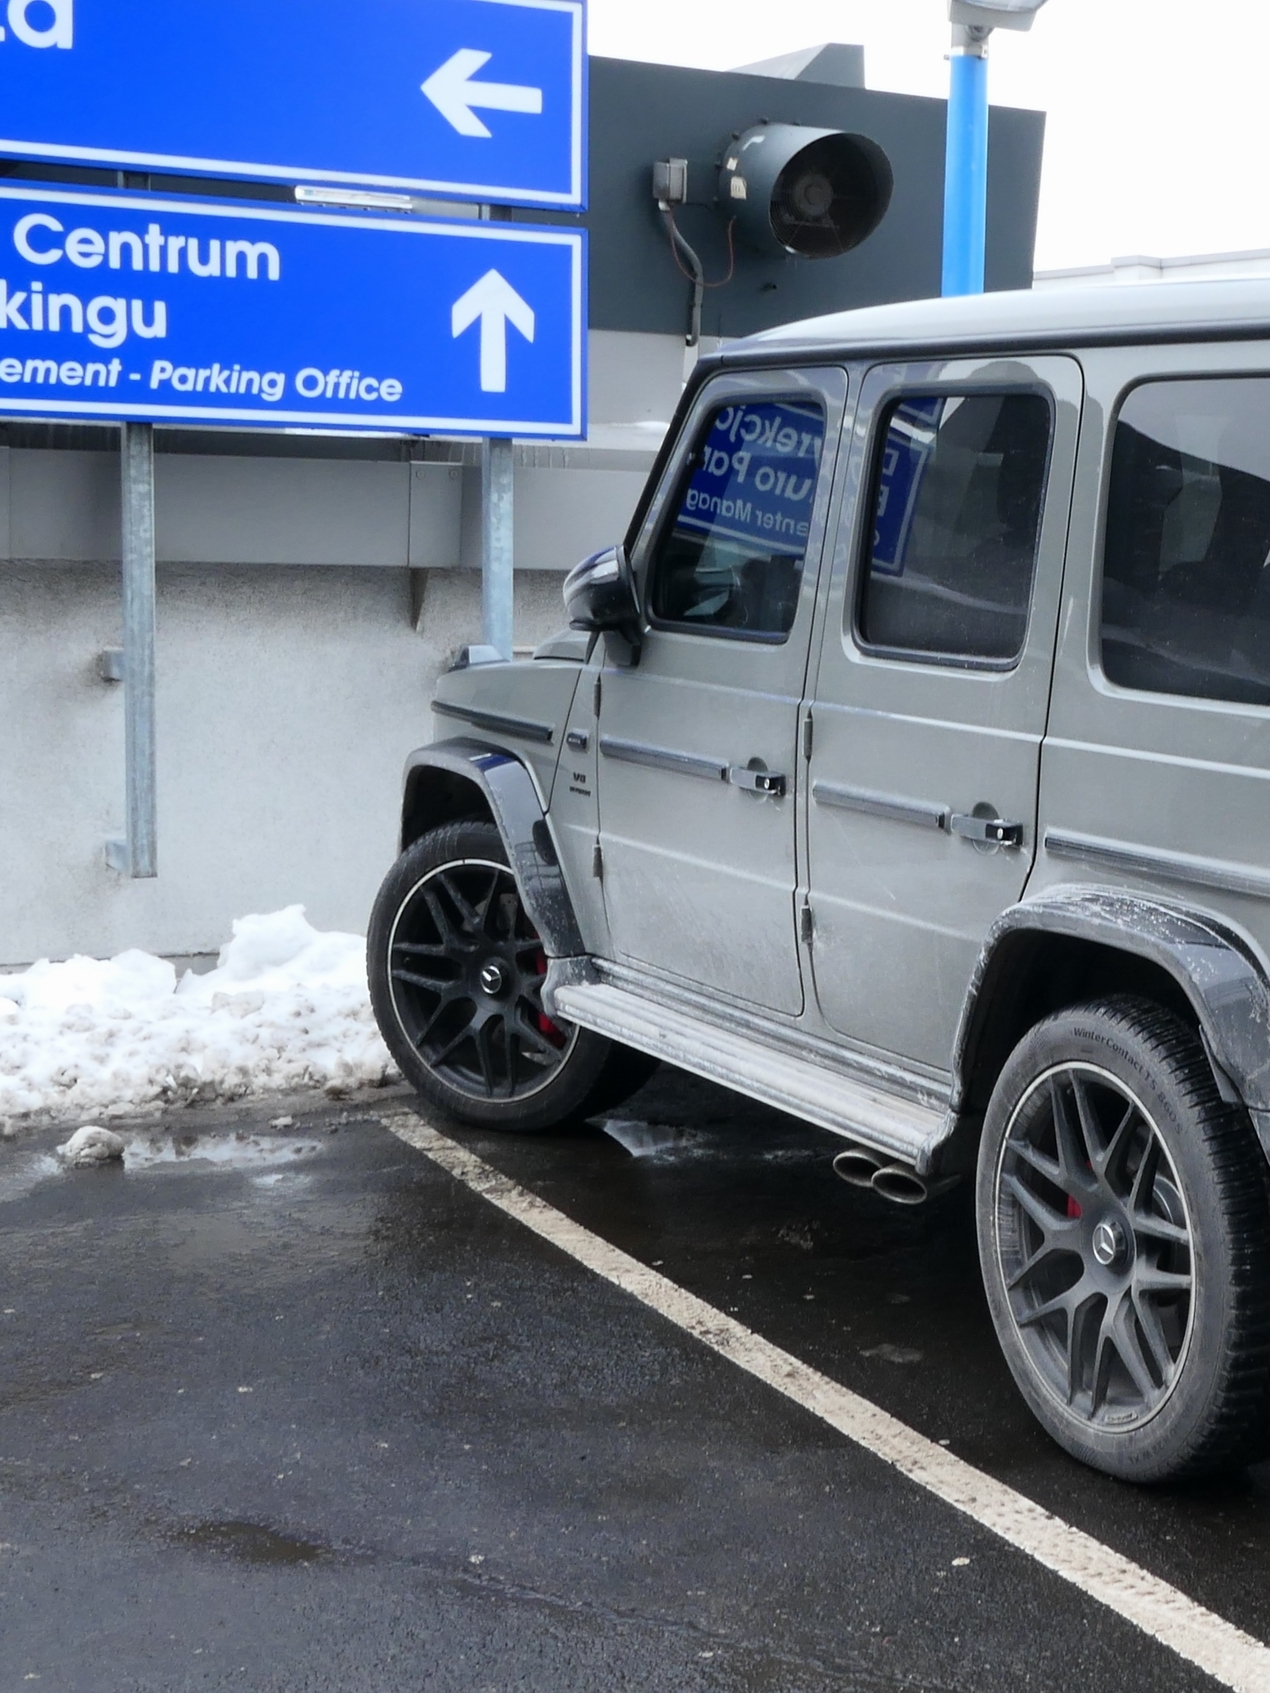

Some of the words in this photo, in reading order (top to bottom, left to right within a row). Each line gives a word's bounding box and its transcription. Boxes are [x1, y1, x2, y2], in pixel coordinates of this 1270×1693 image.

[0, 0, 73, 49] a
[13, 213, 280, 281] Centrum
[0, 279, 167, 349] kingu
[0, 357, 122, 388] ement
[150, 360, 286, 402] Parking
[295, 367, 403, 402] Office
